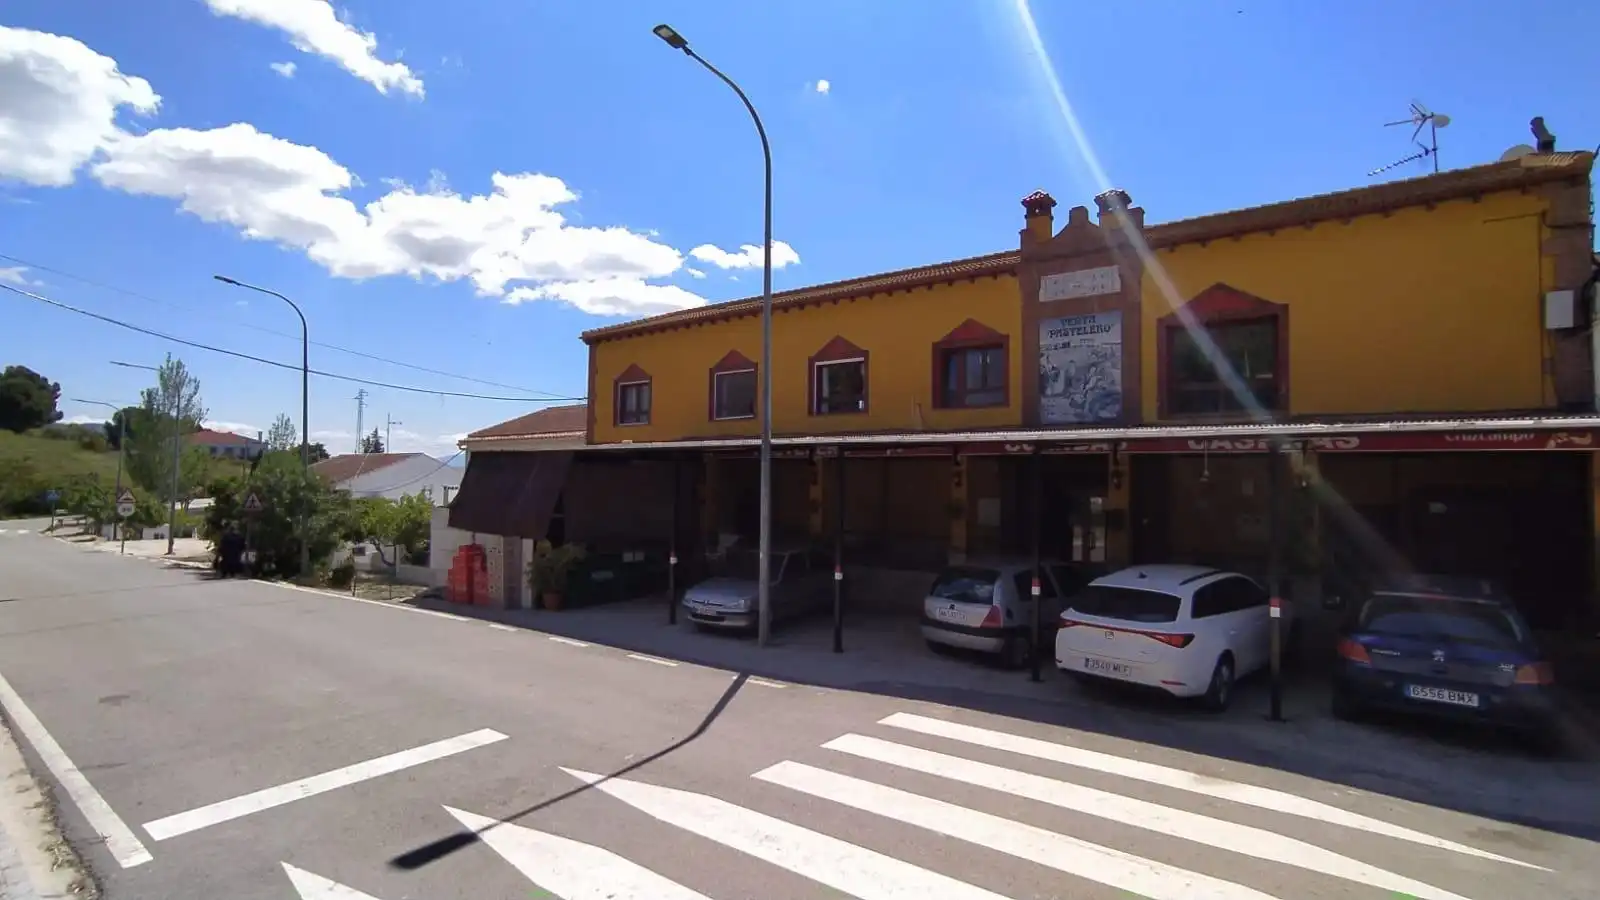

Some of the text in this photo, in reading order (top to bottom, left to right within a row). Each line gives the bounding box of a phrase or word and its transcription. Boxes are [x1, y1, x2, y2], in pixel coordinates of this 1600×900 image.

[1187, 436, 1361, 451] CASAS
[1412, 686, 1473, 704] 6556 BMX
